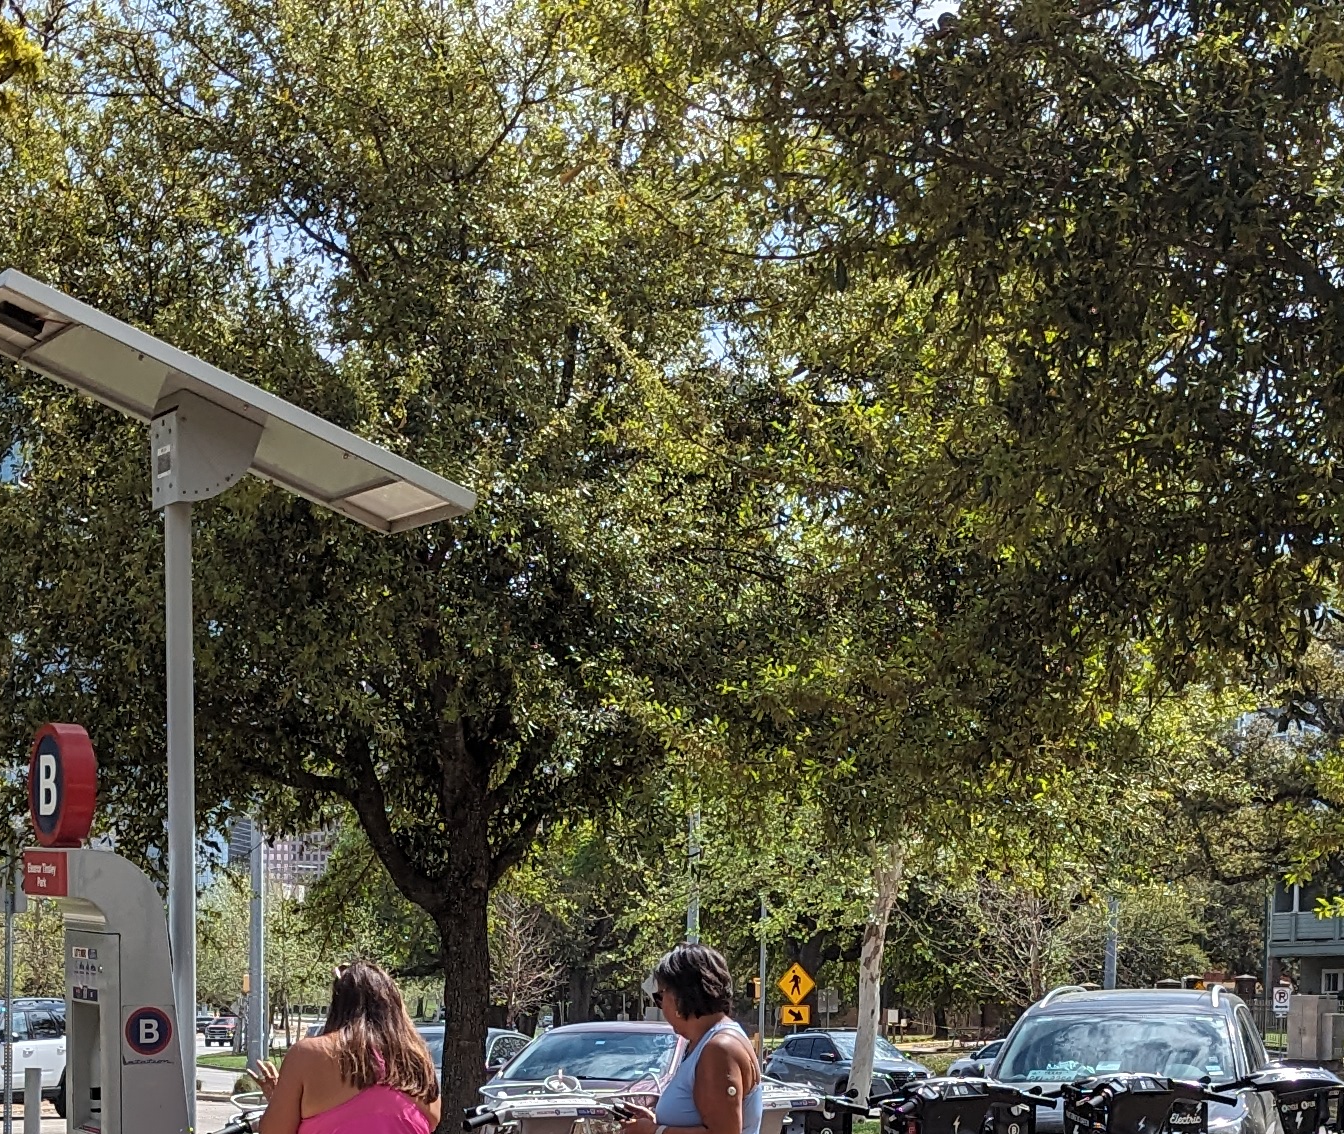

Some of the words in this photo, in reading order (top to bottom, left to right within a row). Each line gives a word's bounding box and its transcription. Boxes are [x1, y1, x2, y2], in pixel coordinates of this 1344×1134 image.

[39, 754, 57, 816] B
[139, 1019, 160, 1044] B
[1169, 1113, 1202, 1125] Electric
